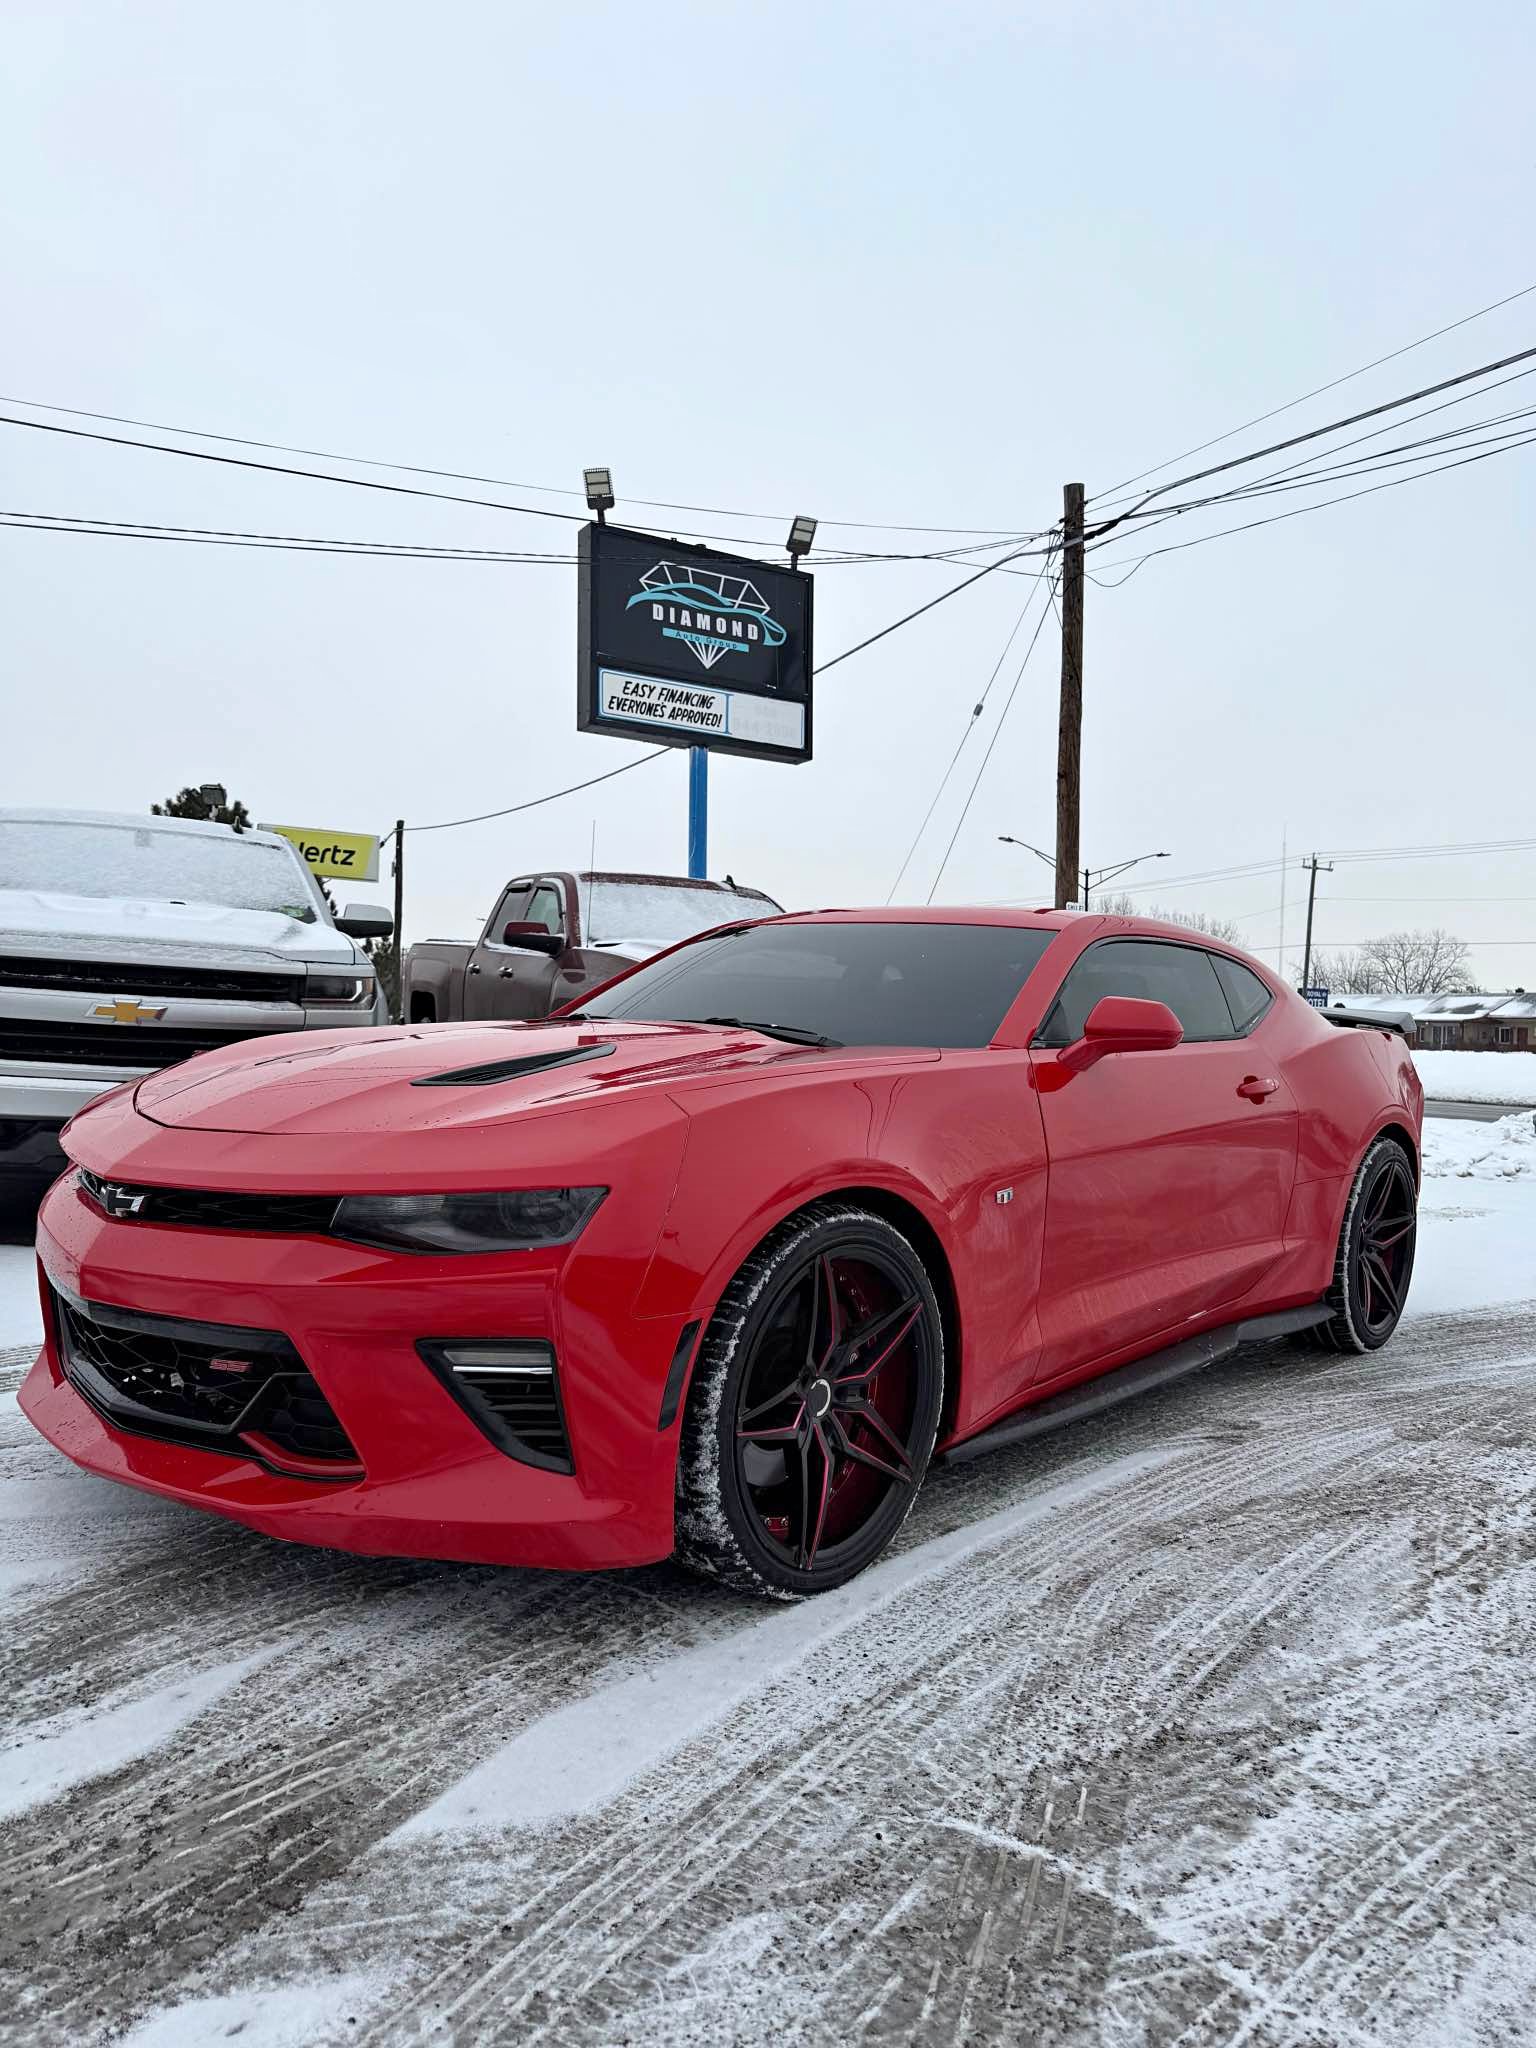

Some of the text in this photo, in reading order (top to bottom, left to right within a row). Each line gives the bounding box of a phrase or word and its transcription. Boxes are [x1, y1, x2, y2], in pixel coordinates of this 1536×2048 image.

[652, 603, 759, 640] DIAMOND
[675, 631, 737, 649] Auto Group
[622, 681, 716, 710] EASY FINANCING
[608, 695, 667, 718] EVERYONE'S
[668, 706, 722, 728] APPROVED!
[299, 841, 356, 866] ertz
[1307, 998, 1328, 1008] OTEL
